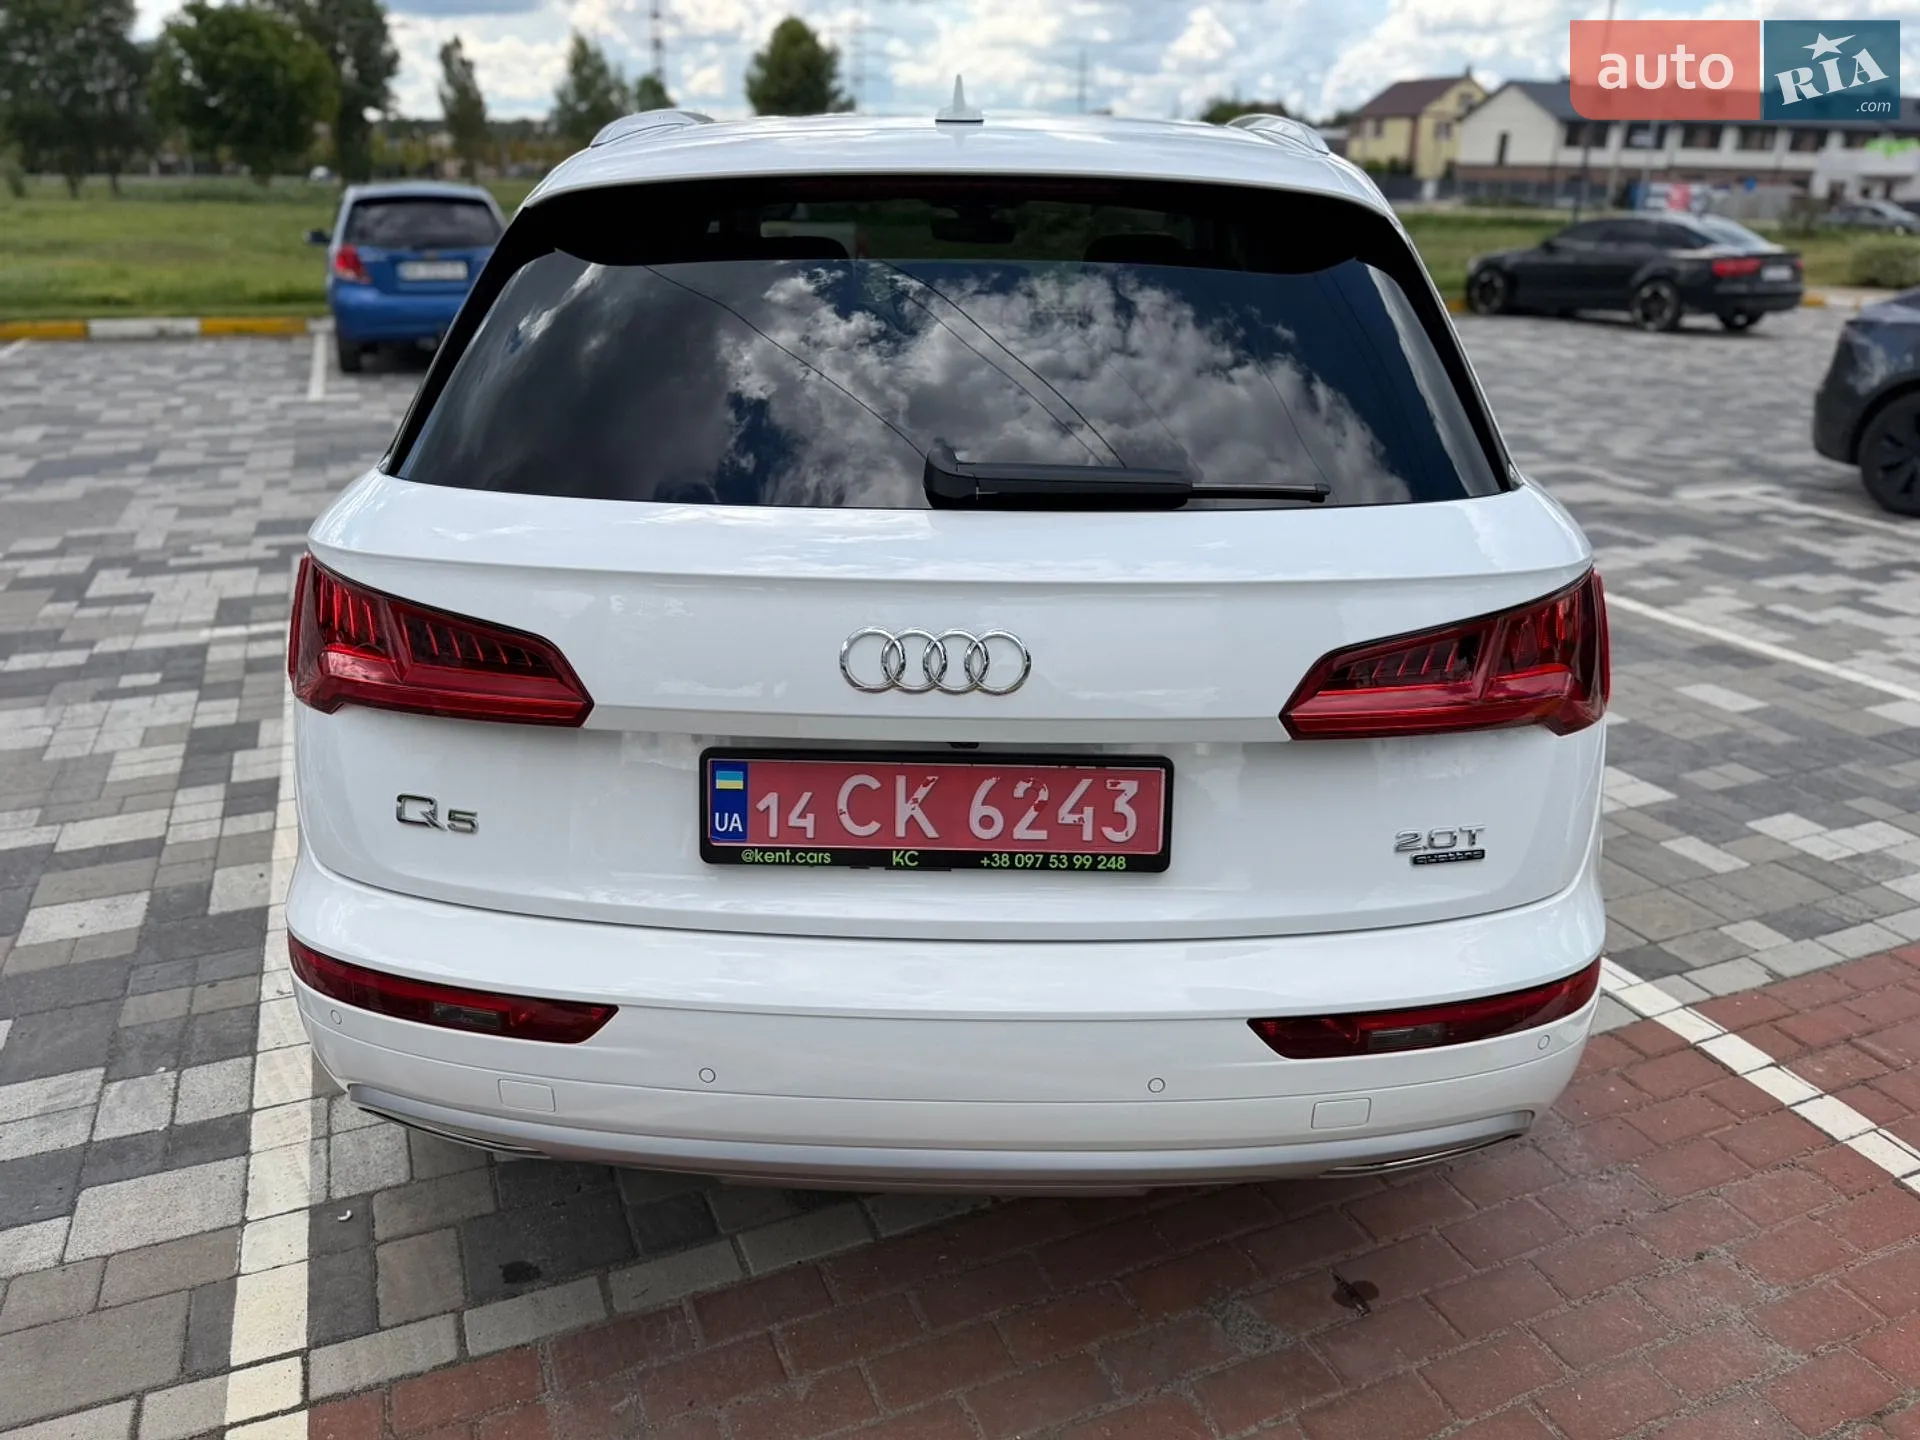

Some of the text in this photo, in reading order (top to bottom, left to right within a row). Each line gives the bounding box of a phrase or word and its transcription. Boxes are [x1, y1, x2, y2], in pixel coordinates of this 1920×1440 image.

[396, 793, 480, 835] Q5
[756, 774, 1138, 842] 14 CK 6243
[714, 812, 743, 832] UA
[1395, 824, 1485, 852] 2.0T
[741, 848, 832, 864] @kent.cars
[892, 850, 919, 867] KC
[980, 853, 1127, 870] +38 097 53 99 248
